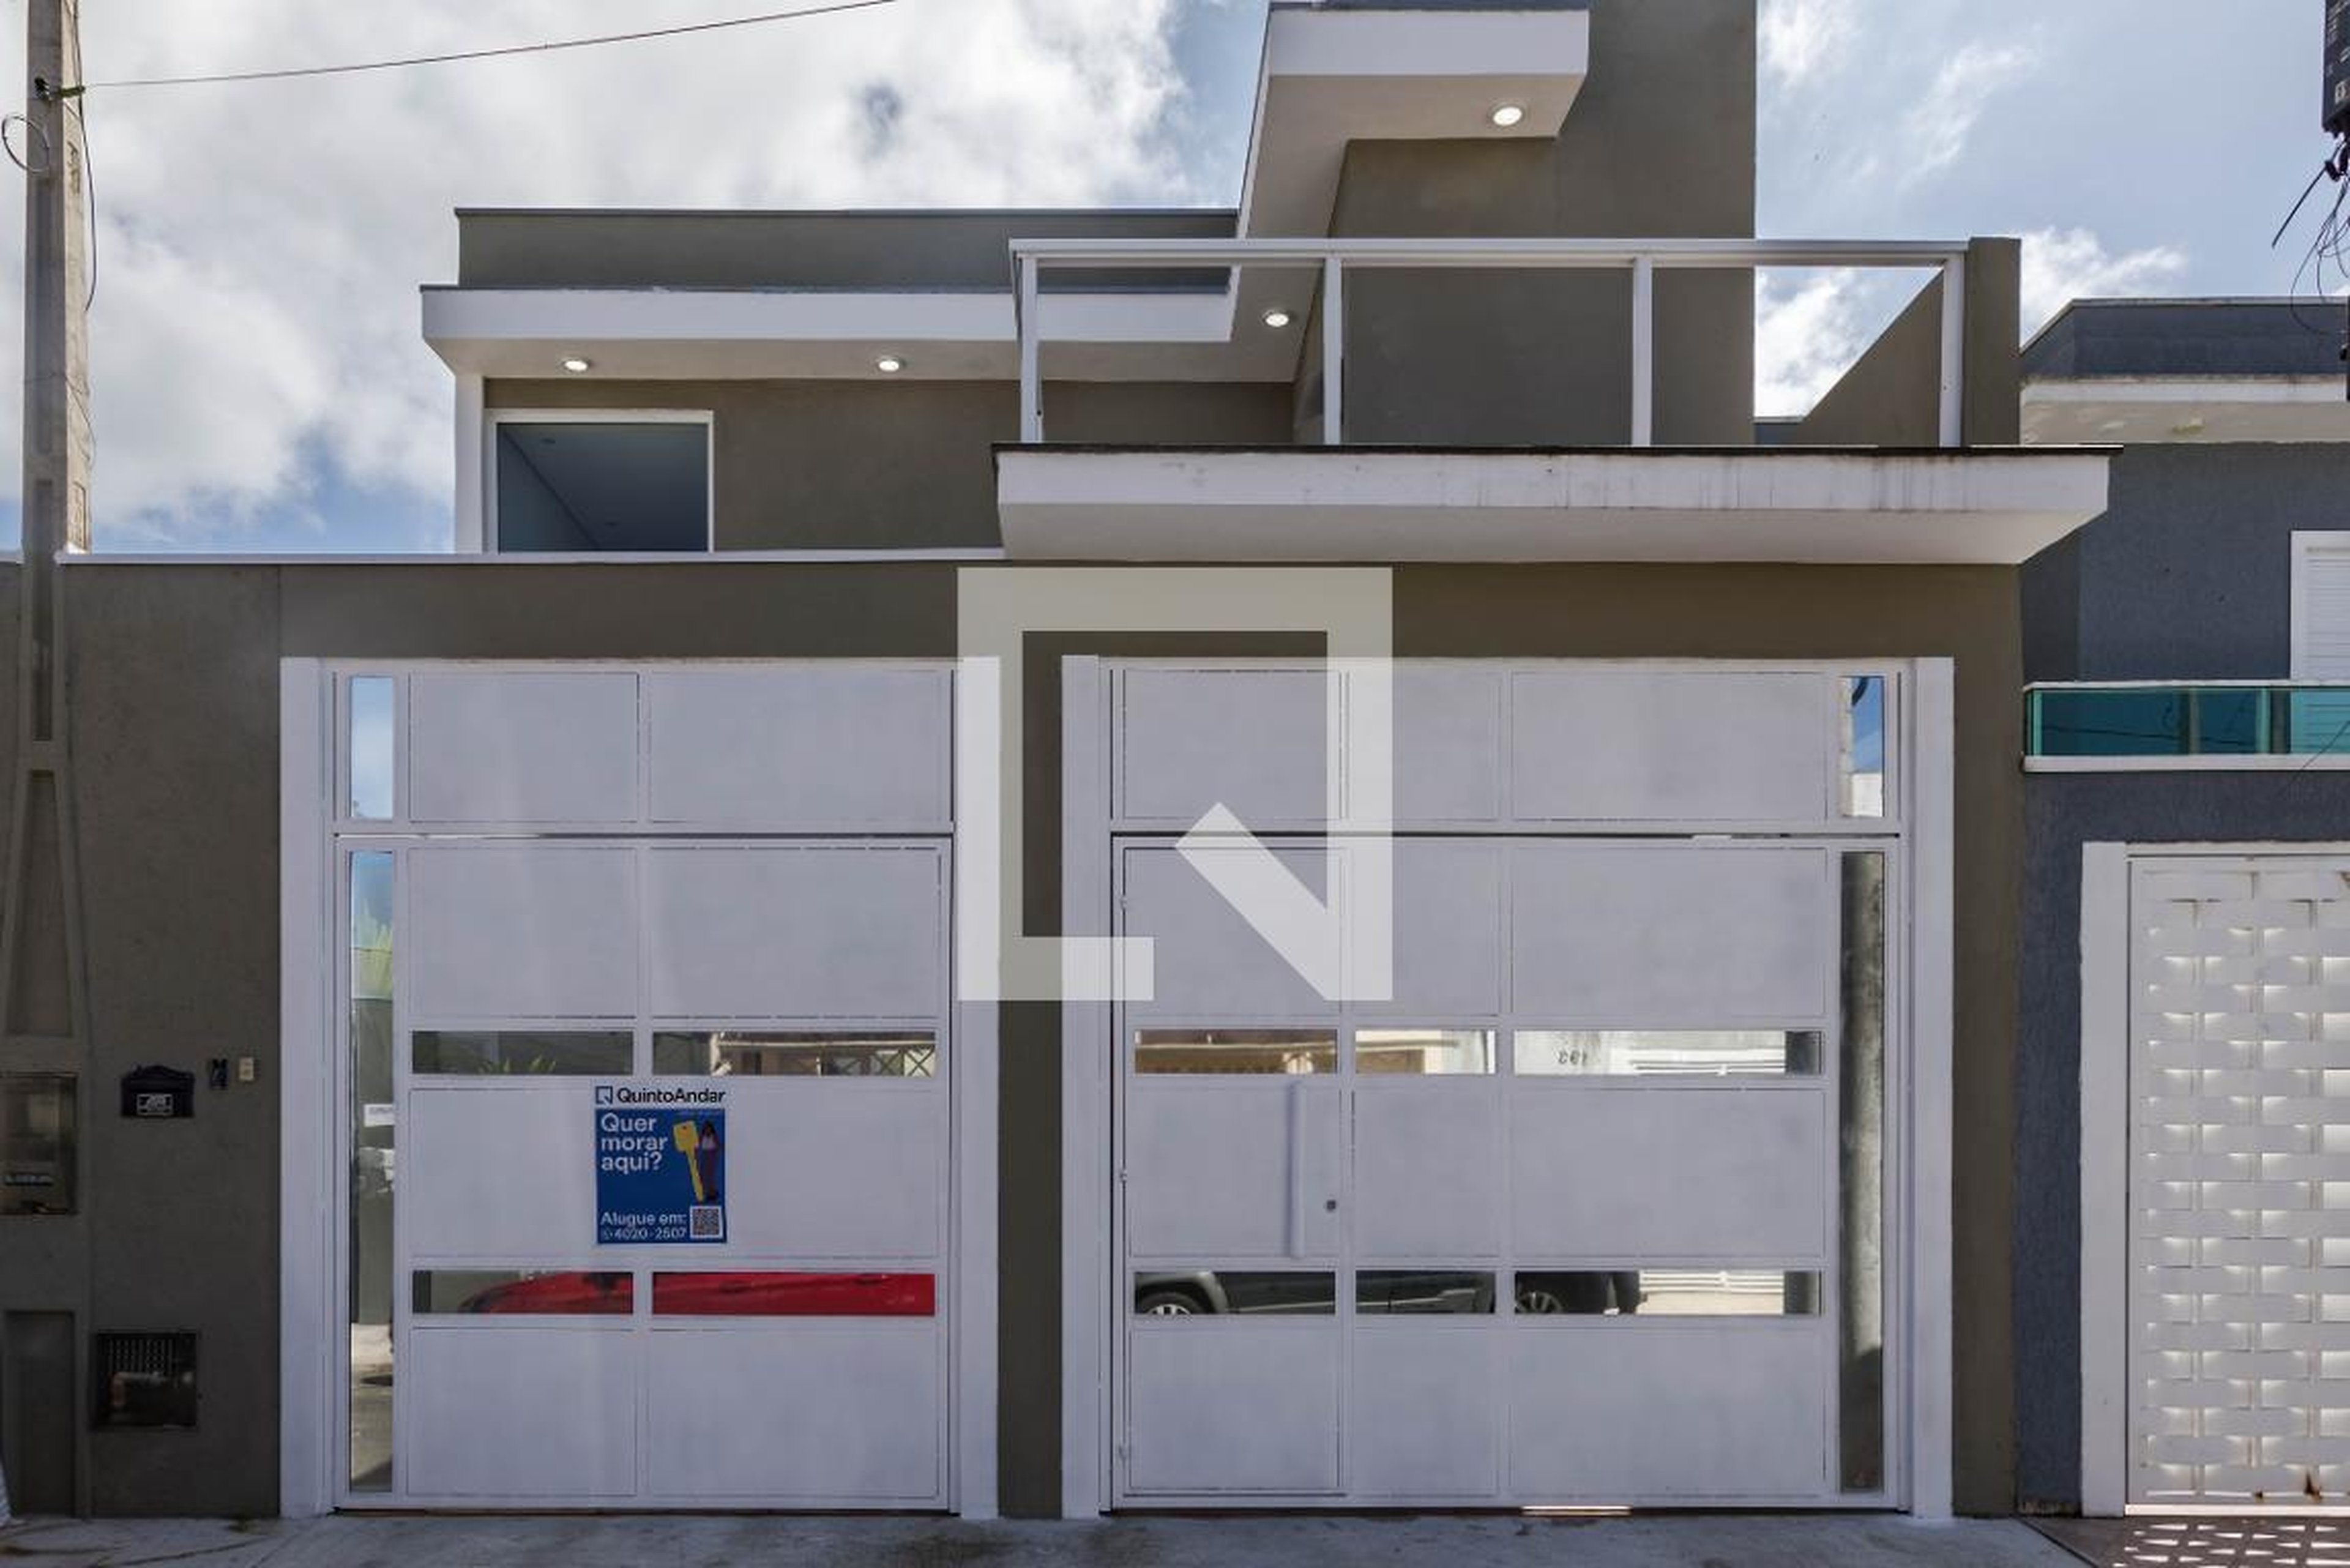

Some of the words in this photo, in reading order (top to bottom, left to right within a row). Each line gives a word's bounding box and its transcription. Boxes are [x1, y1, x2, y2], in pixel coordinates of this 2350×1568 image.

[617, 1088, 725, 1103] QuintoAndar
[601, 1113, 657, 1132] Quer
[601, 1137, 668, 1151] morar
[601, 1151, 662, 1174] aqui?
[600, 1212, 655, 1228] Alugue
[658, 1214, 687, 1225] em:
